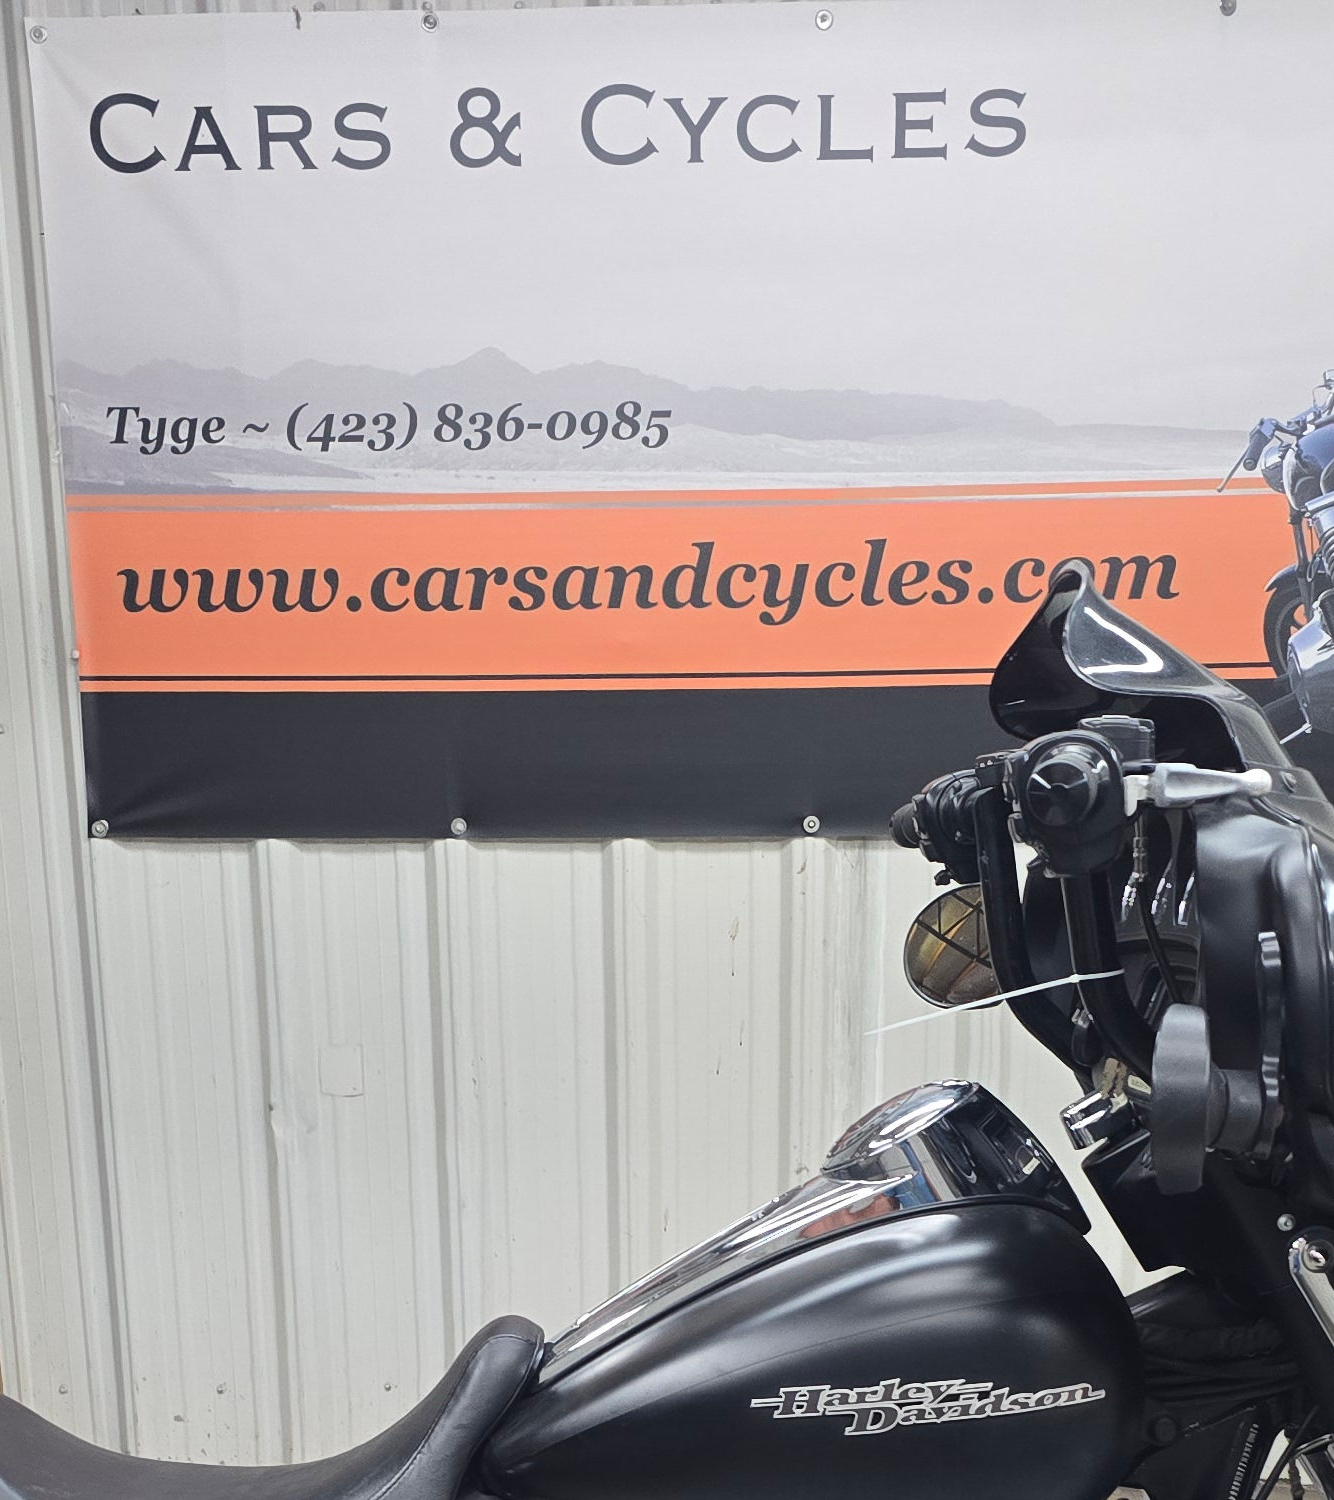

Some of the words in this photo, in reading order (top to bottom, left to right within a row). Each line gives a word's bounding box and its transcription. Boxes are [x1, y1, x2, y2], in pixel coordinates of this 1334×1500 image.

[449, 87, 522, 169] &
[106, 406, 226, 456] Tyge
[286, 402, 418, 452] (423)
[433, 400, 672, 451] 836-0985
[762, 1378, 981, 1418] Harley
[839, 1383, 1106, 1436] Davidson
